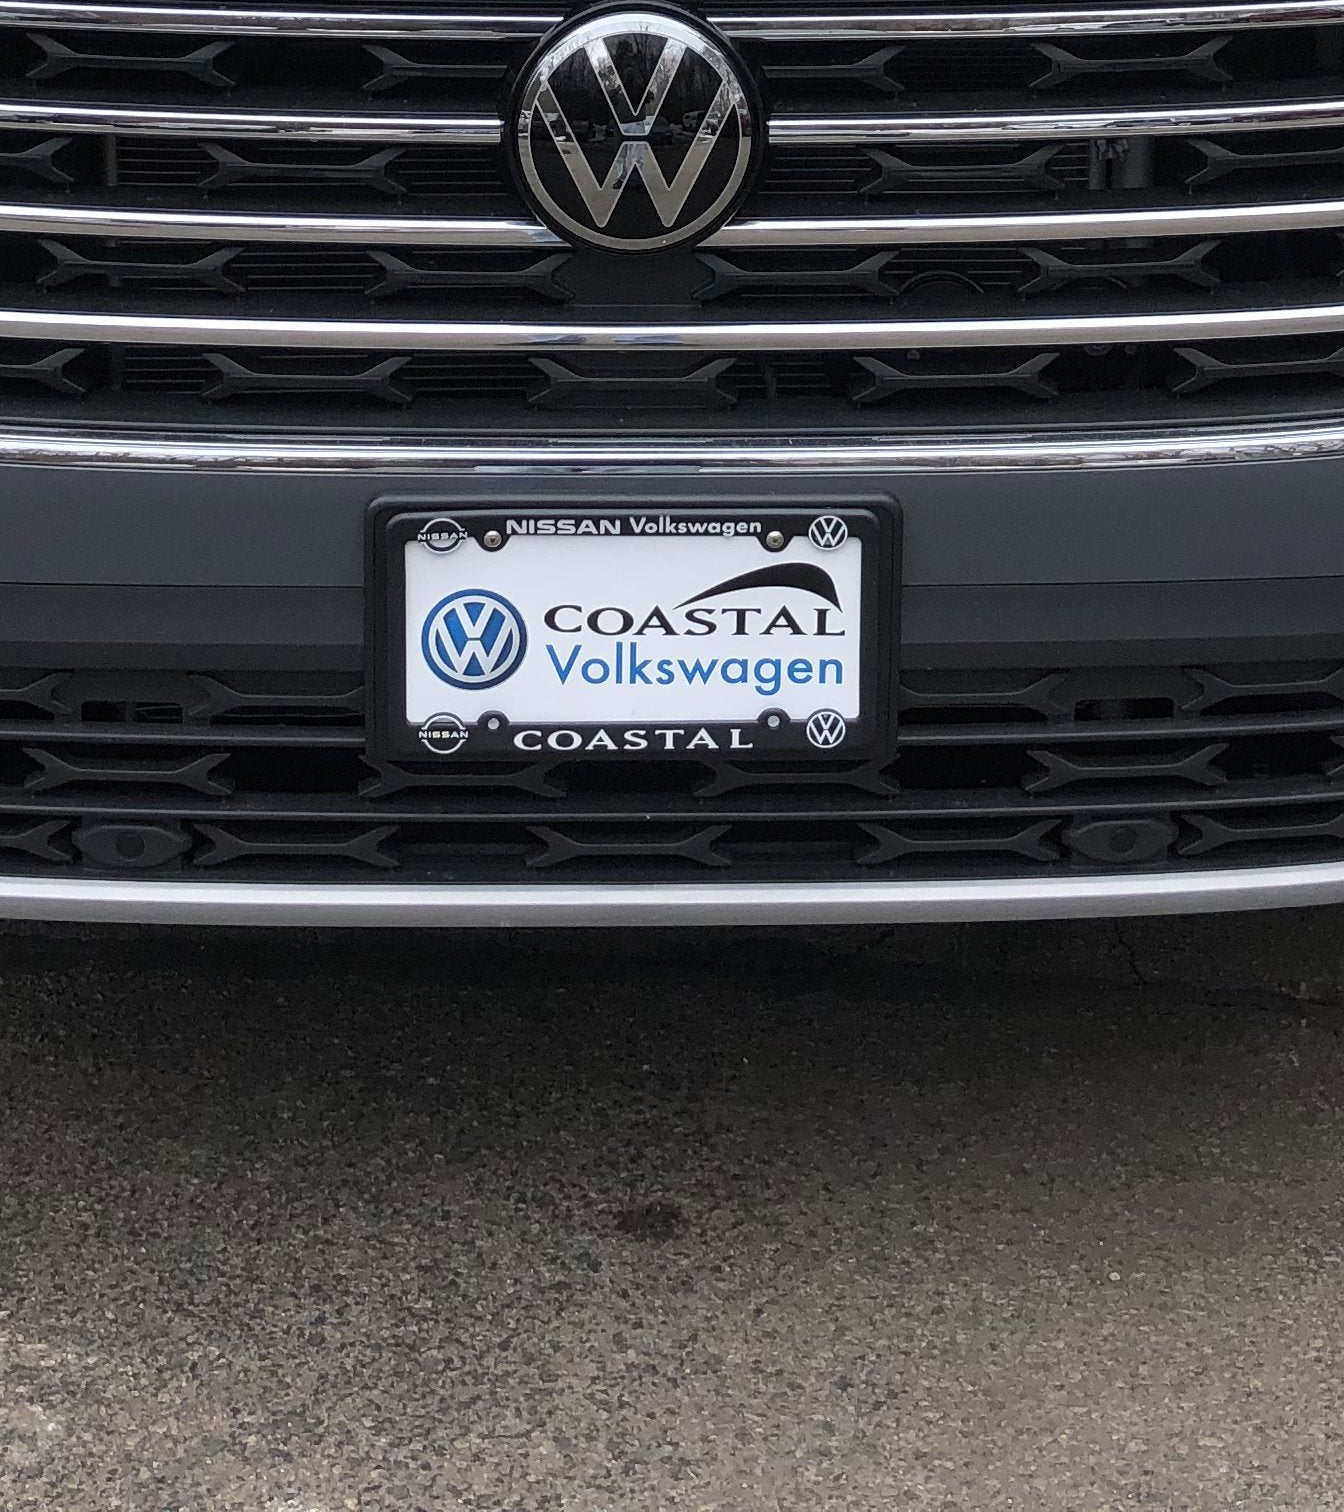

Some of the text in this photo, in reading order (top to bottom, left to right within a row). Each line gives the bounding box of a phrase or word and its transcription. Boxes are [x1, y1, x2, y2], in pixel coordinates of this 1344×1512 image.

[417, 531, 468, 541] NISSAN
[506, 515, 762, 537] NISSAN Volkswagen
[543, 604, 846, 637] COASTAL
[545, 641, 844, 696] Volkswagen
[418, 730, 469, 739] NISSAN
[513, 727, 754, 751] COASTAL
